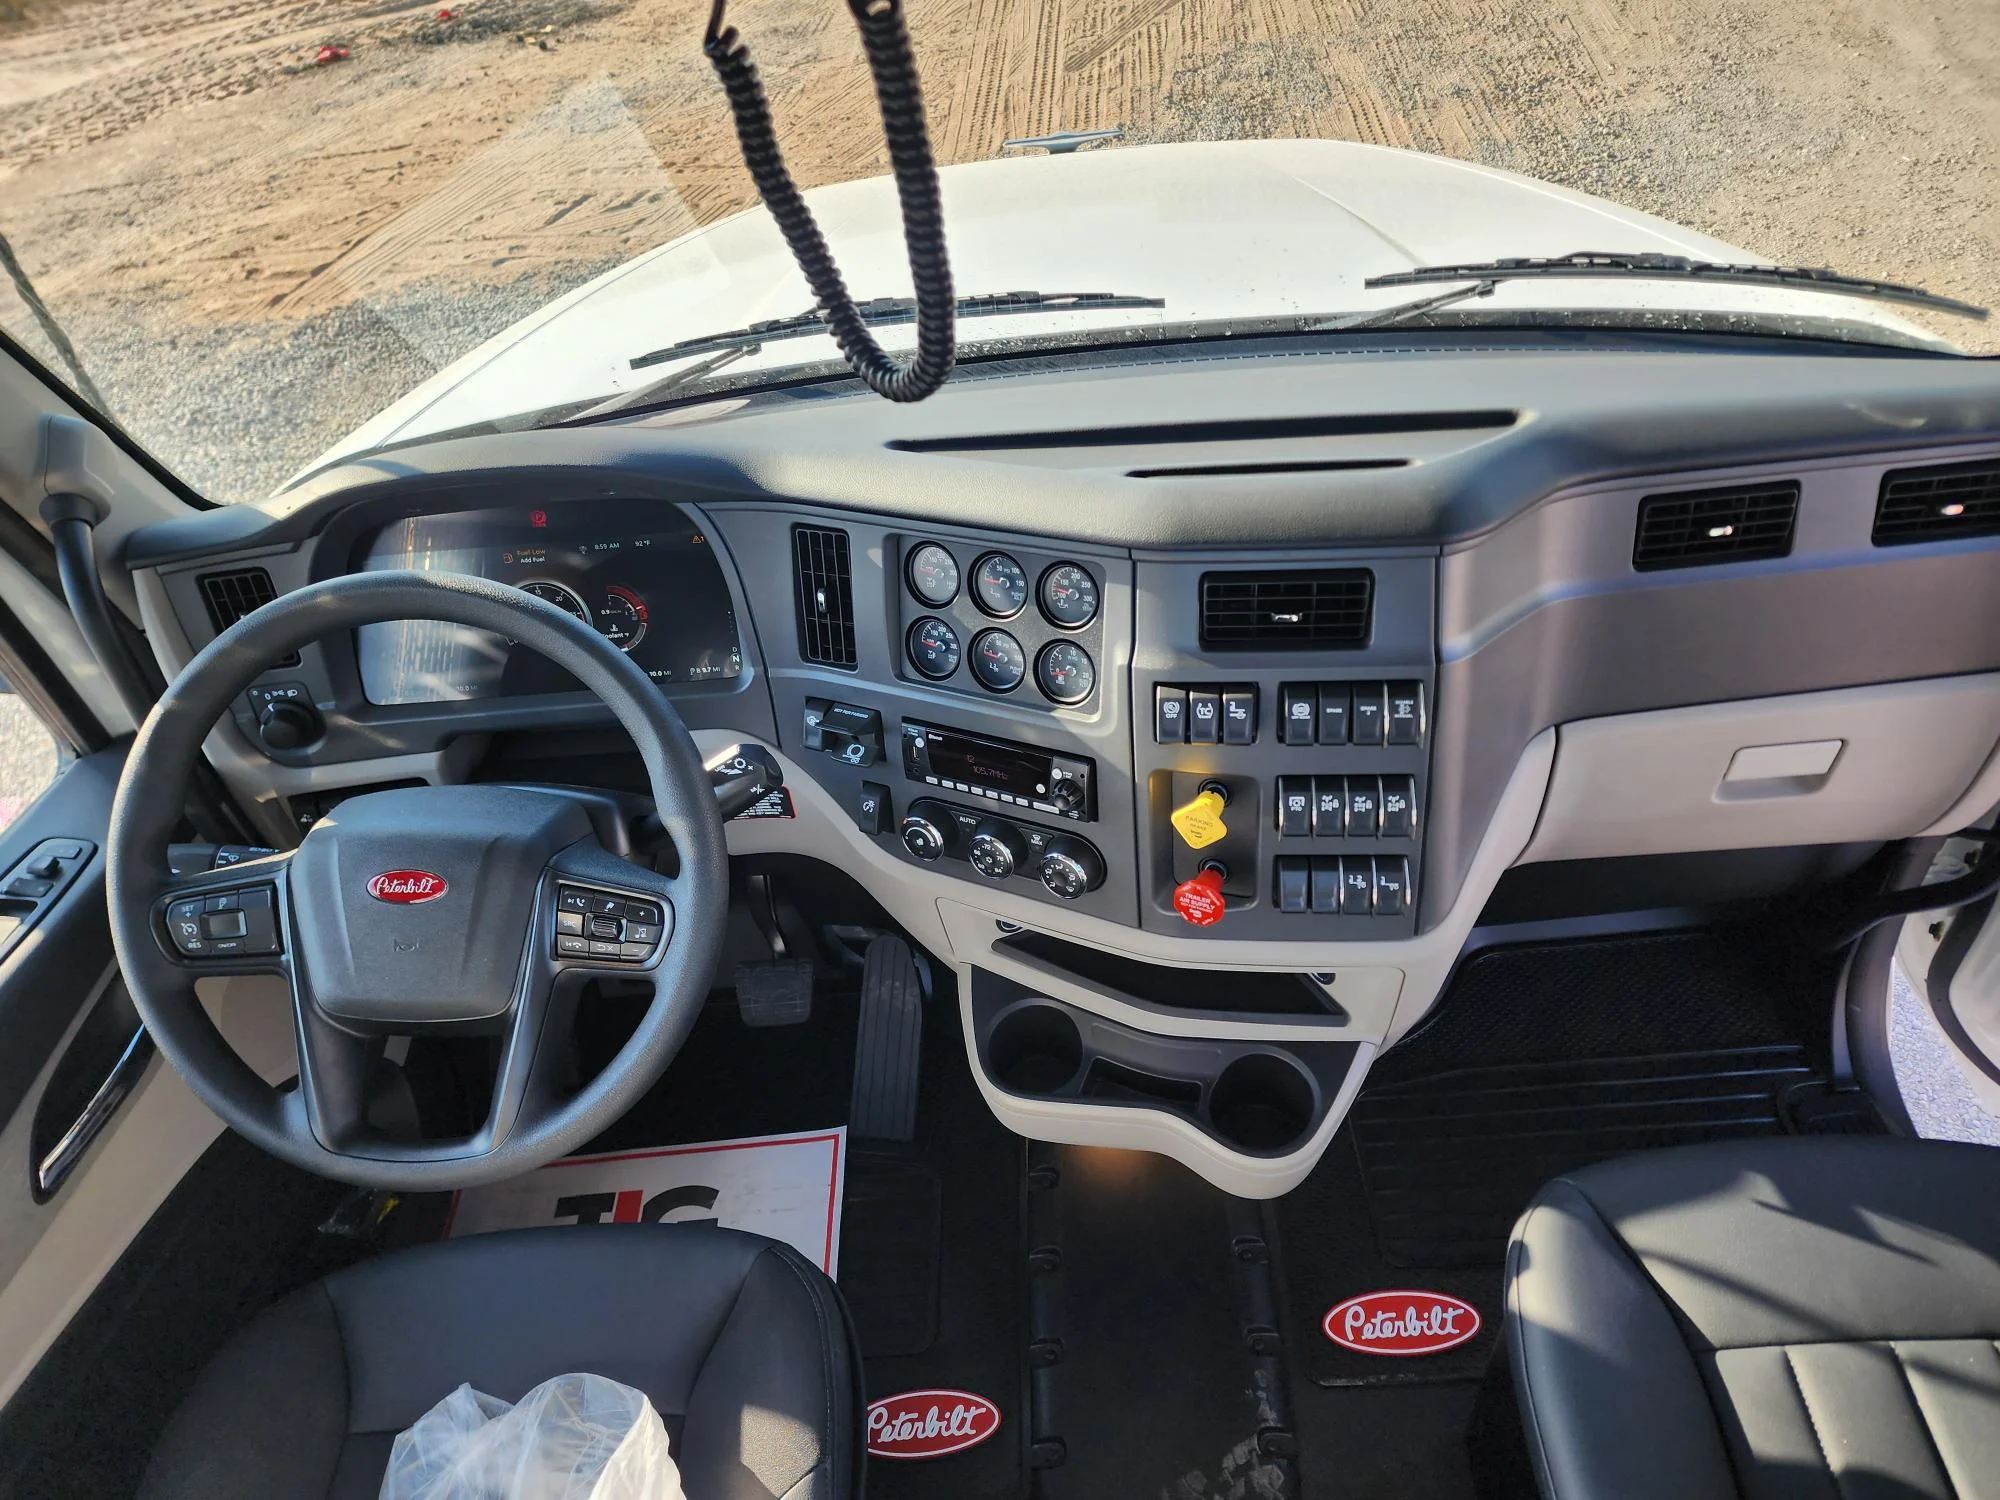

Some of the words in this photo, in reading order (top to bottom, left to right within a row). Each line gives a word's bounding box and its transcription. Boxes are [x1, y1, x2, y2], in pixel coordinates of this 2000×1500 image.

[959, 816, 976, 825] AUTO
[376, 876, 439, 895] Peterbilt
[1179, 896, 1190, 904] AIR
[1190, 899, 1215, 910] SUPPLY
[1185, 892, 1211, 904] TRAILER
[1345, 1306, 1465, 1342] Peterbilt
[867, 1405, 987, 1444] Peterbilt
